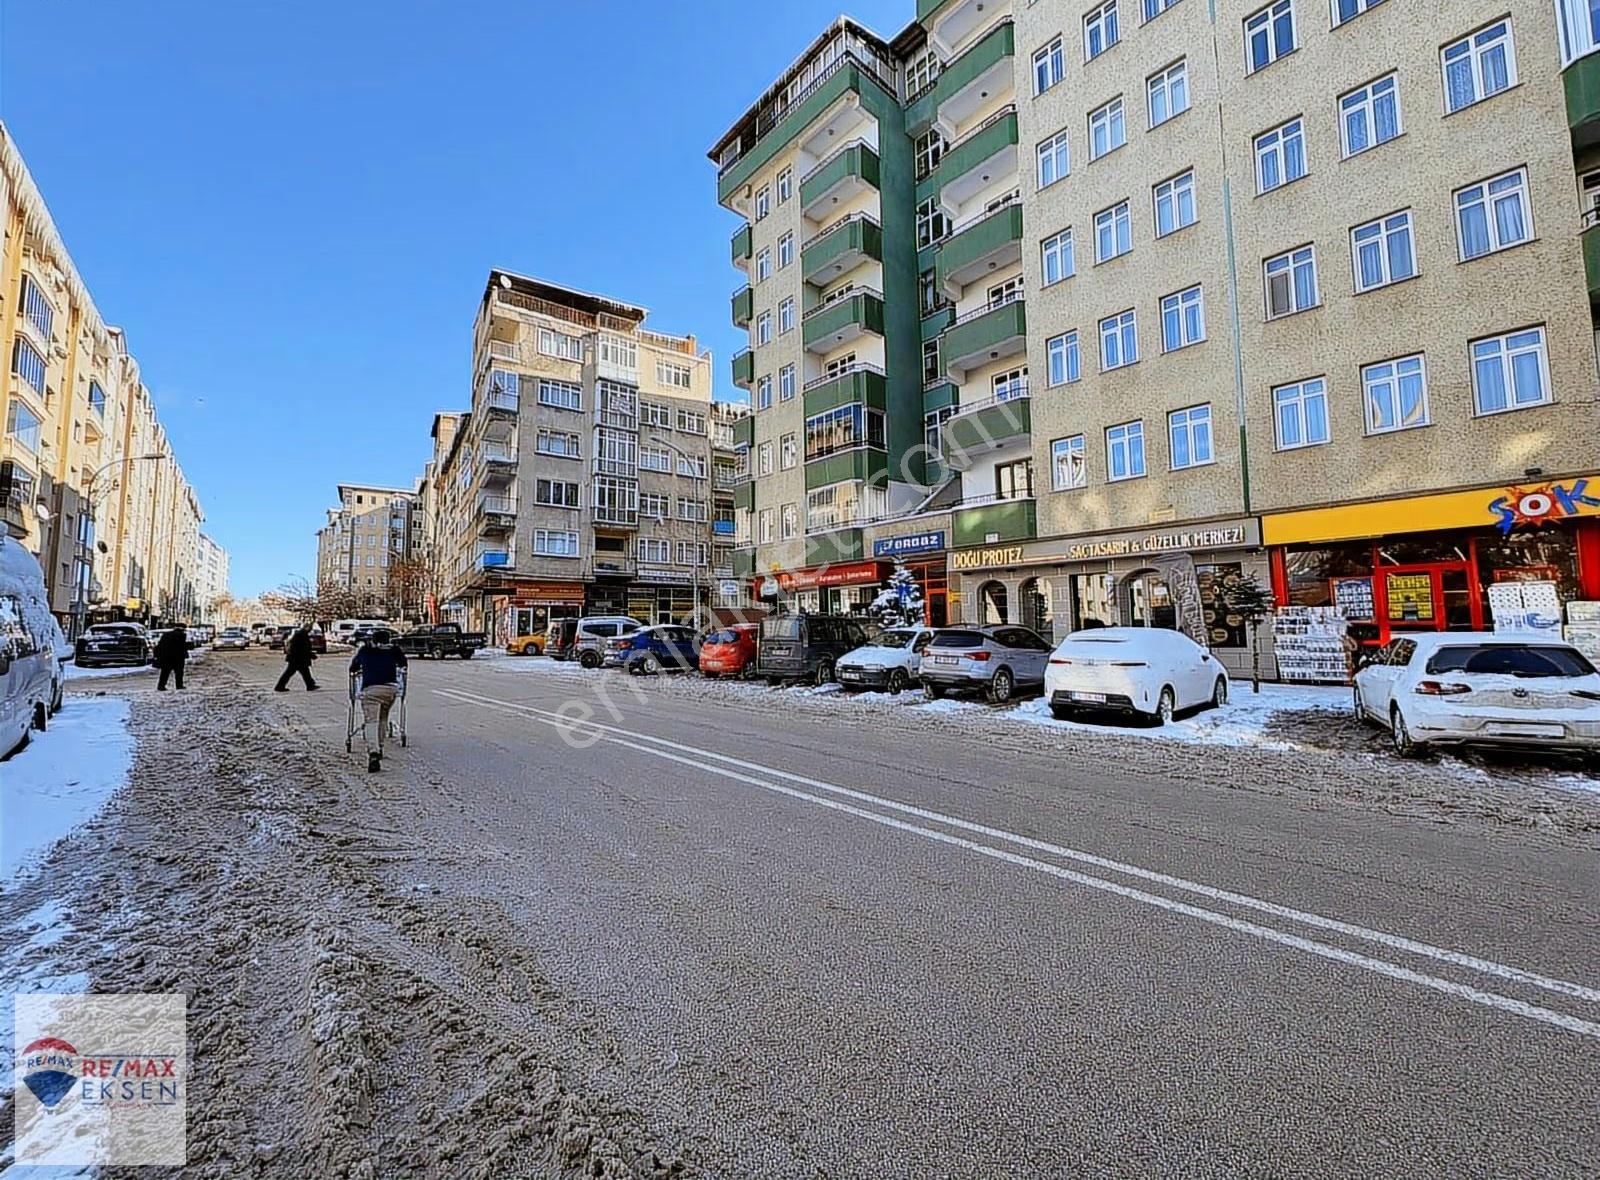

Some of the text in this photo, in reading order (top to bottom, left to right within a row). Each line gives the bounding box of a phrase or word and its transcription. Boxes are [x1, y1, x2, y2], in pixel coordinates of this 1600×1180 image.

[1143, 532, 1192, 551] GÜZELLİK
[1194, 525, 1244, 545] MERKEZİ
[953, 546, 1022, 568] DOĞU PROTEZ
